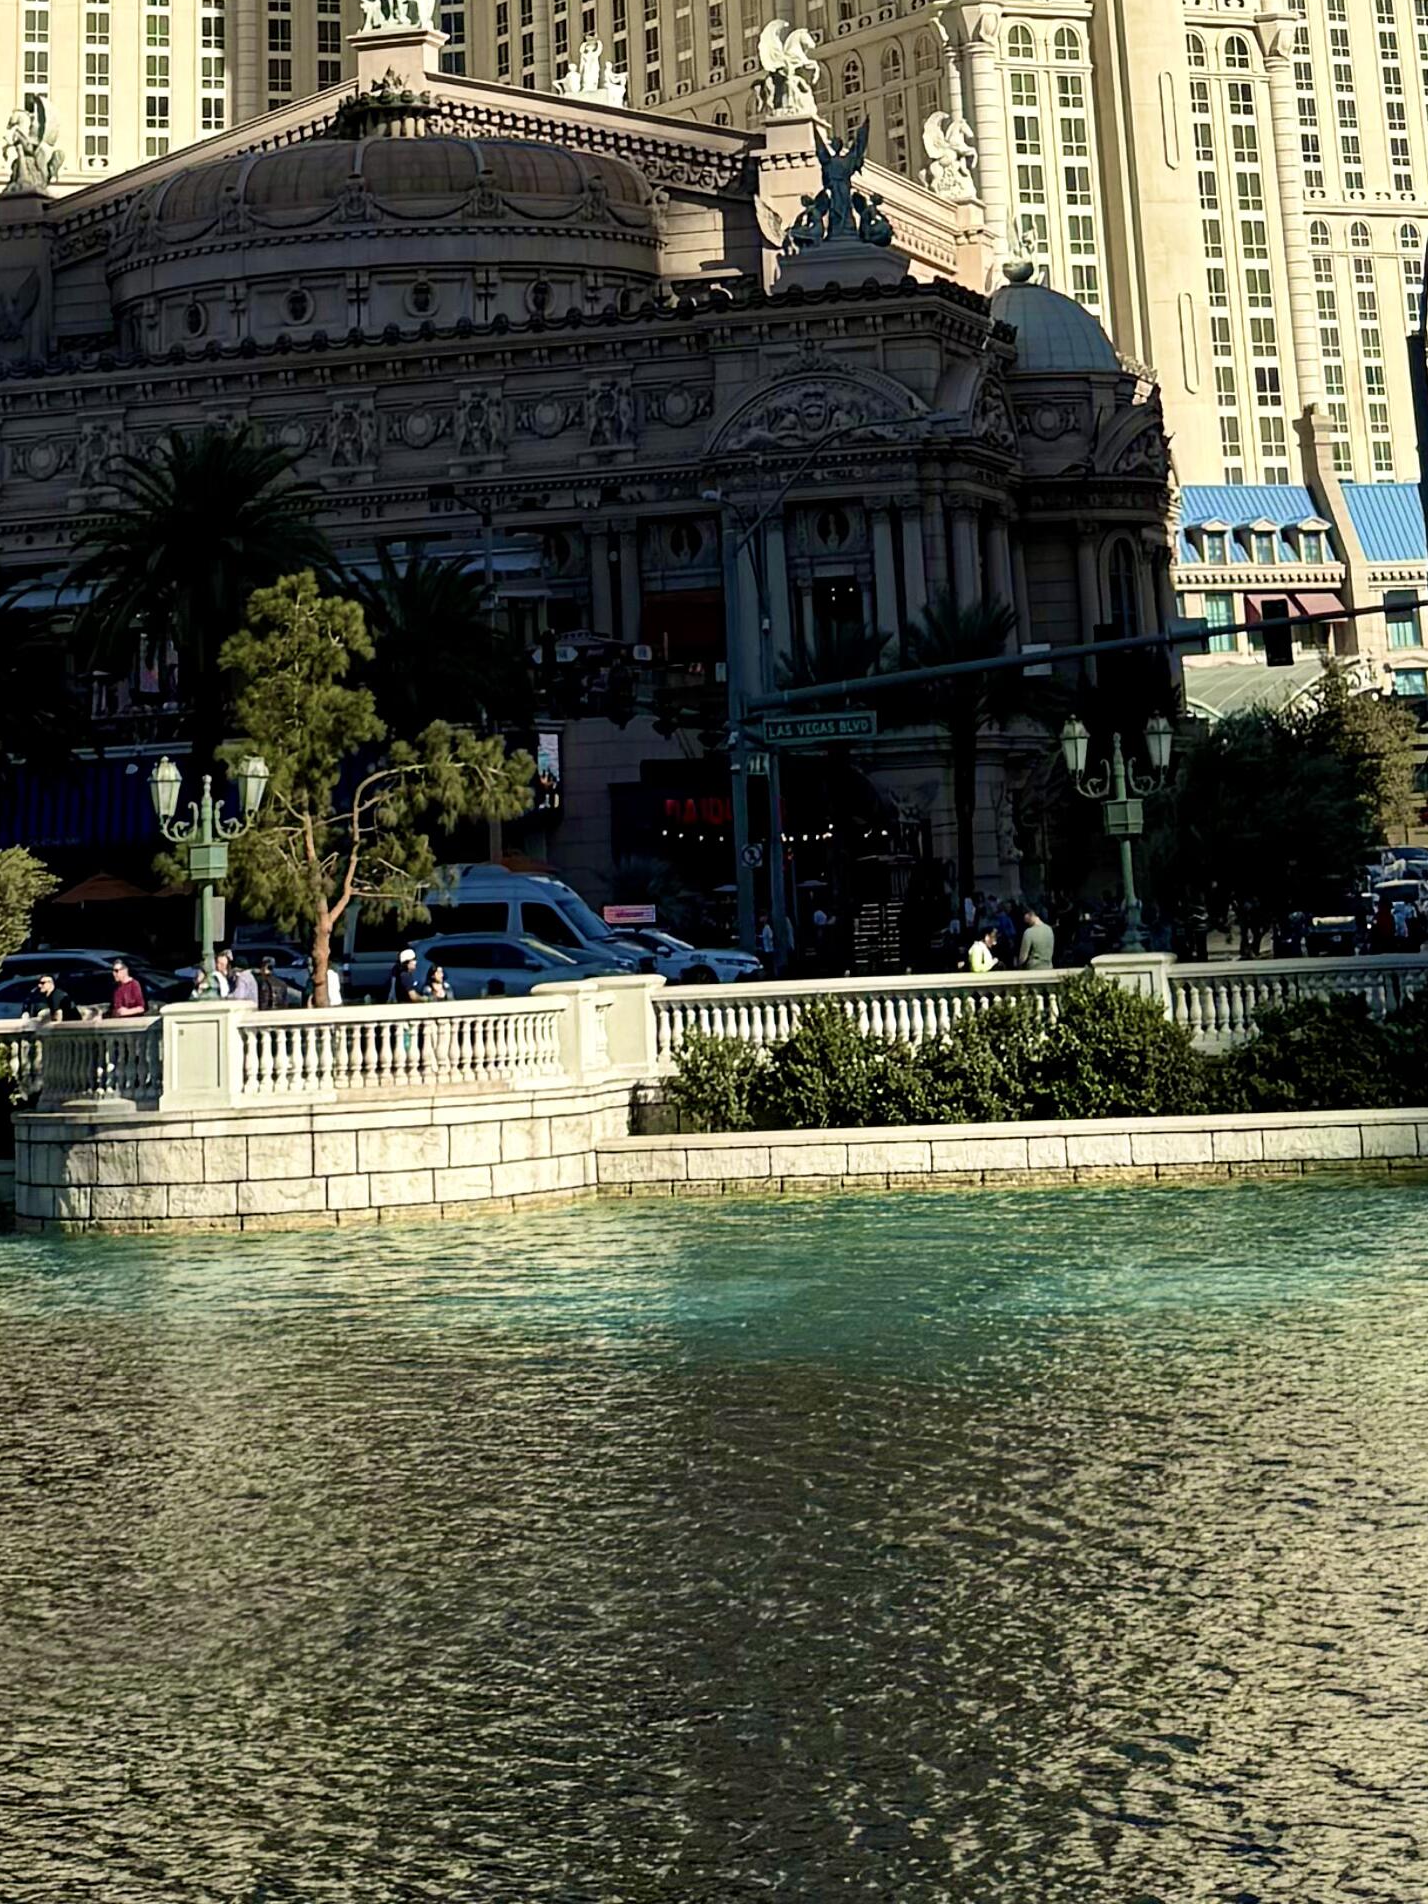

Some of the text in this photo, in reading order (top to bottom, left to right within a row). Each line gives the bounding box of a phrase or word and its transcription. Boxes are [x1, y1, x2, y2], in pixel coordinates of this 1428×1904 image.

[768, 718, 869, 738] LAS VEGAS BLVD
